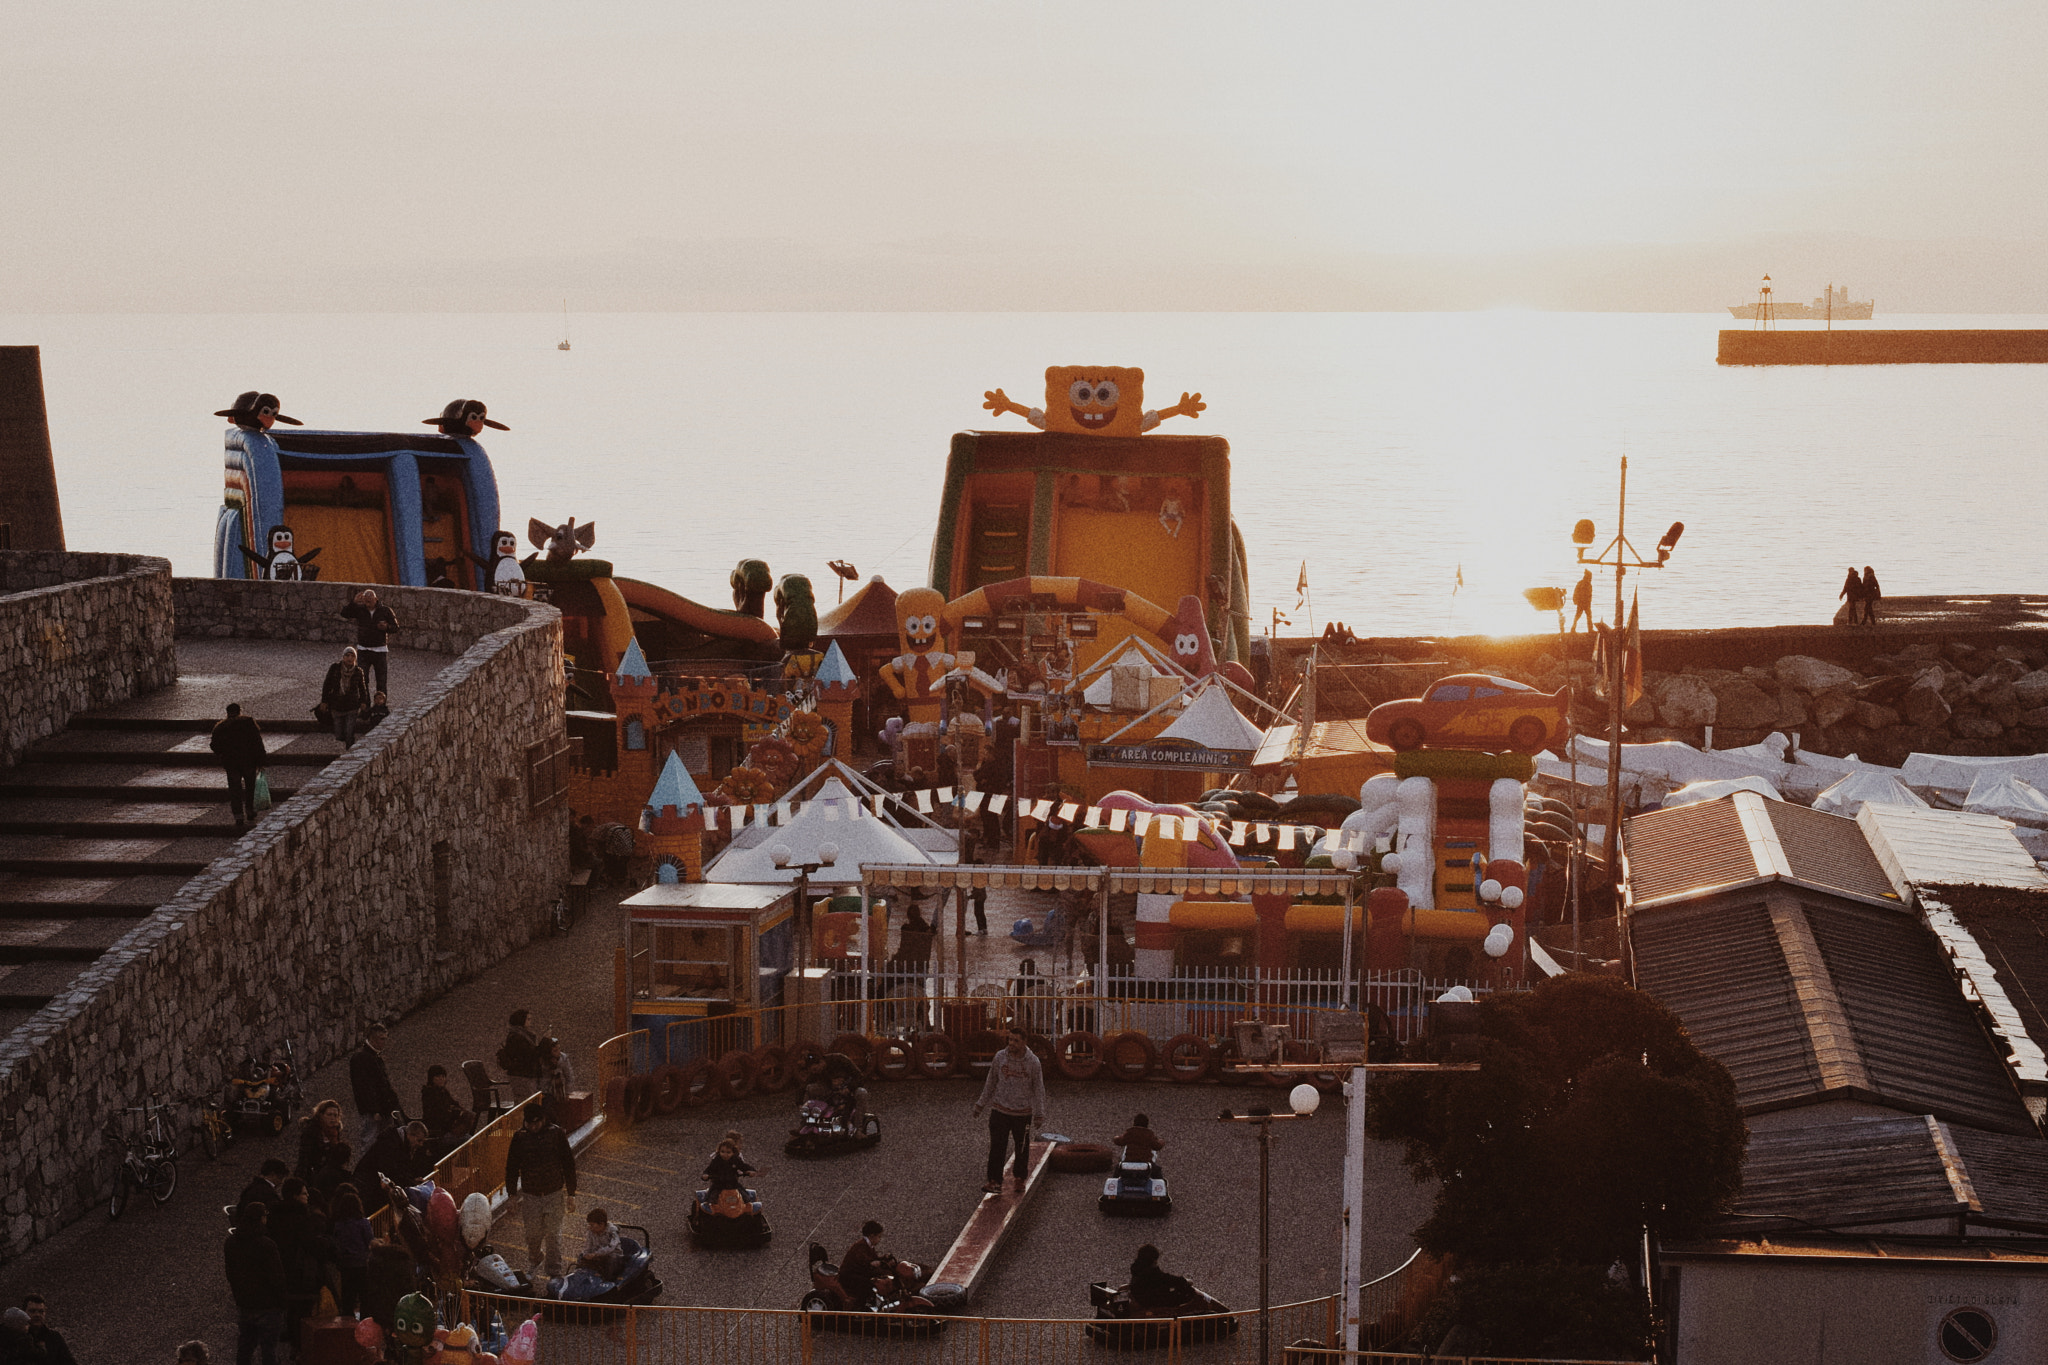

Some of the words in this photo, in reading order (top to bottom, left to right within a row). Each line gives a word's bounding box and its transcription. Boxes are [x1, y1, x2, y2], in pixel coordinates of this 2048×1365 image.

[654, 691, 726, 720] MONDO
[731, 692, 791, 720] BIMBO
[1477, 711, 1505, 734] 95
[1121, 749, 1148, 761] AREA
[1222, 754, 1229, 765] 2
